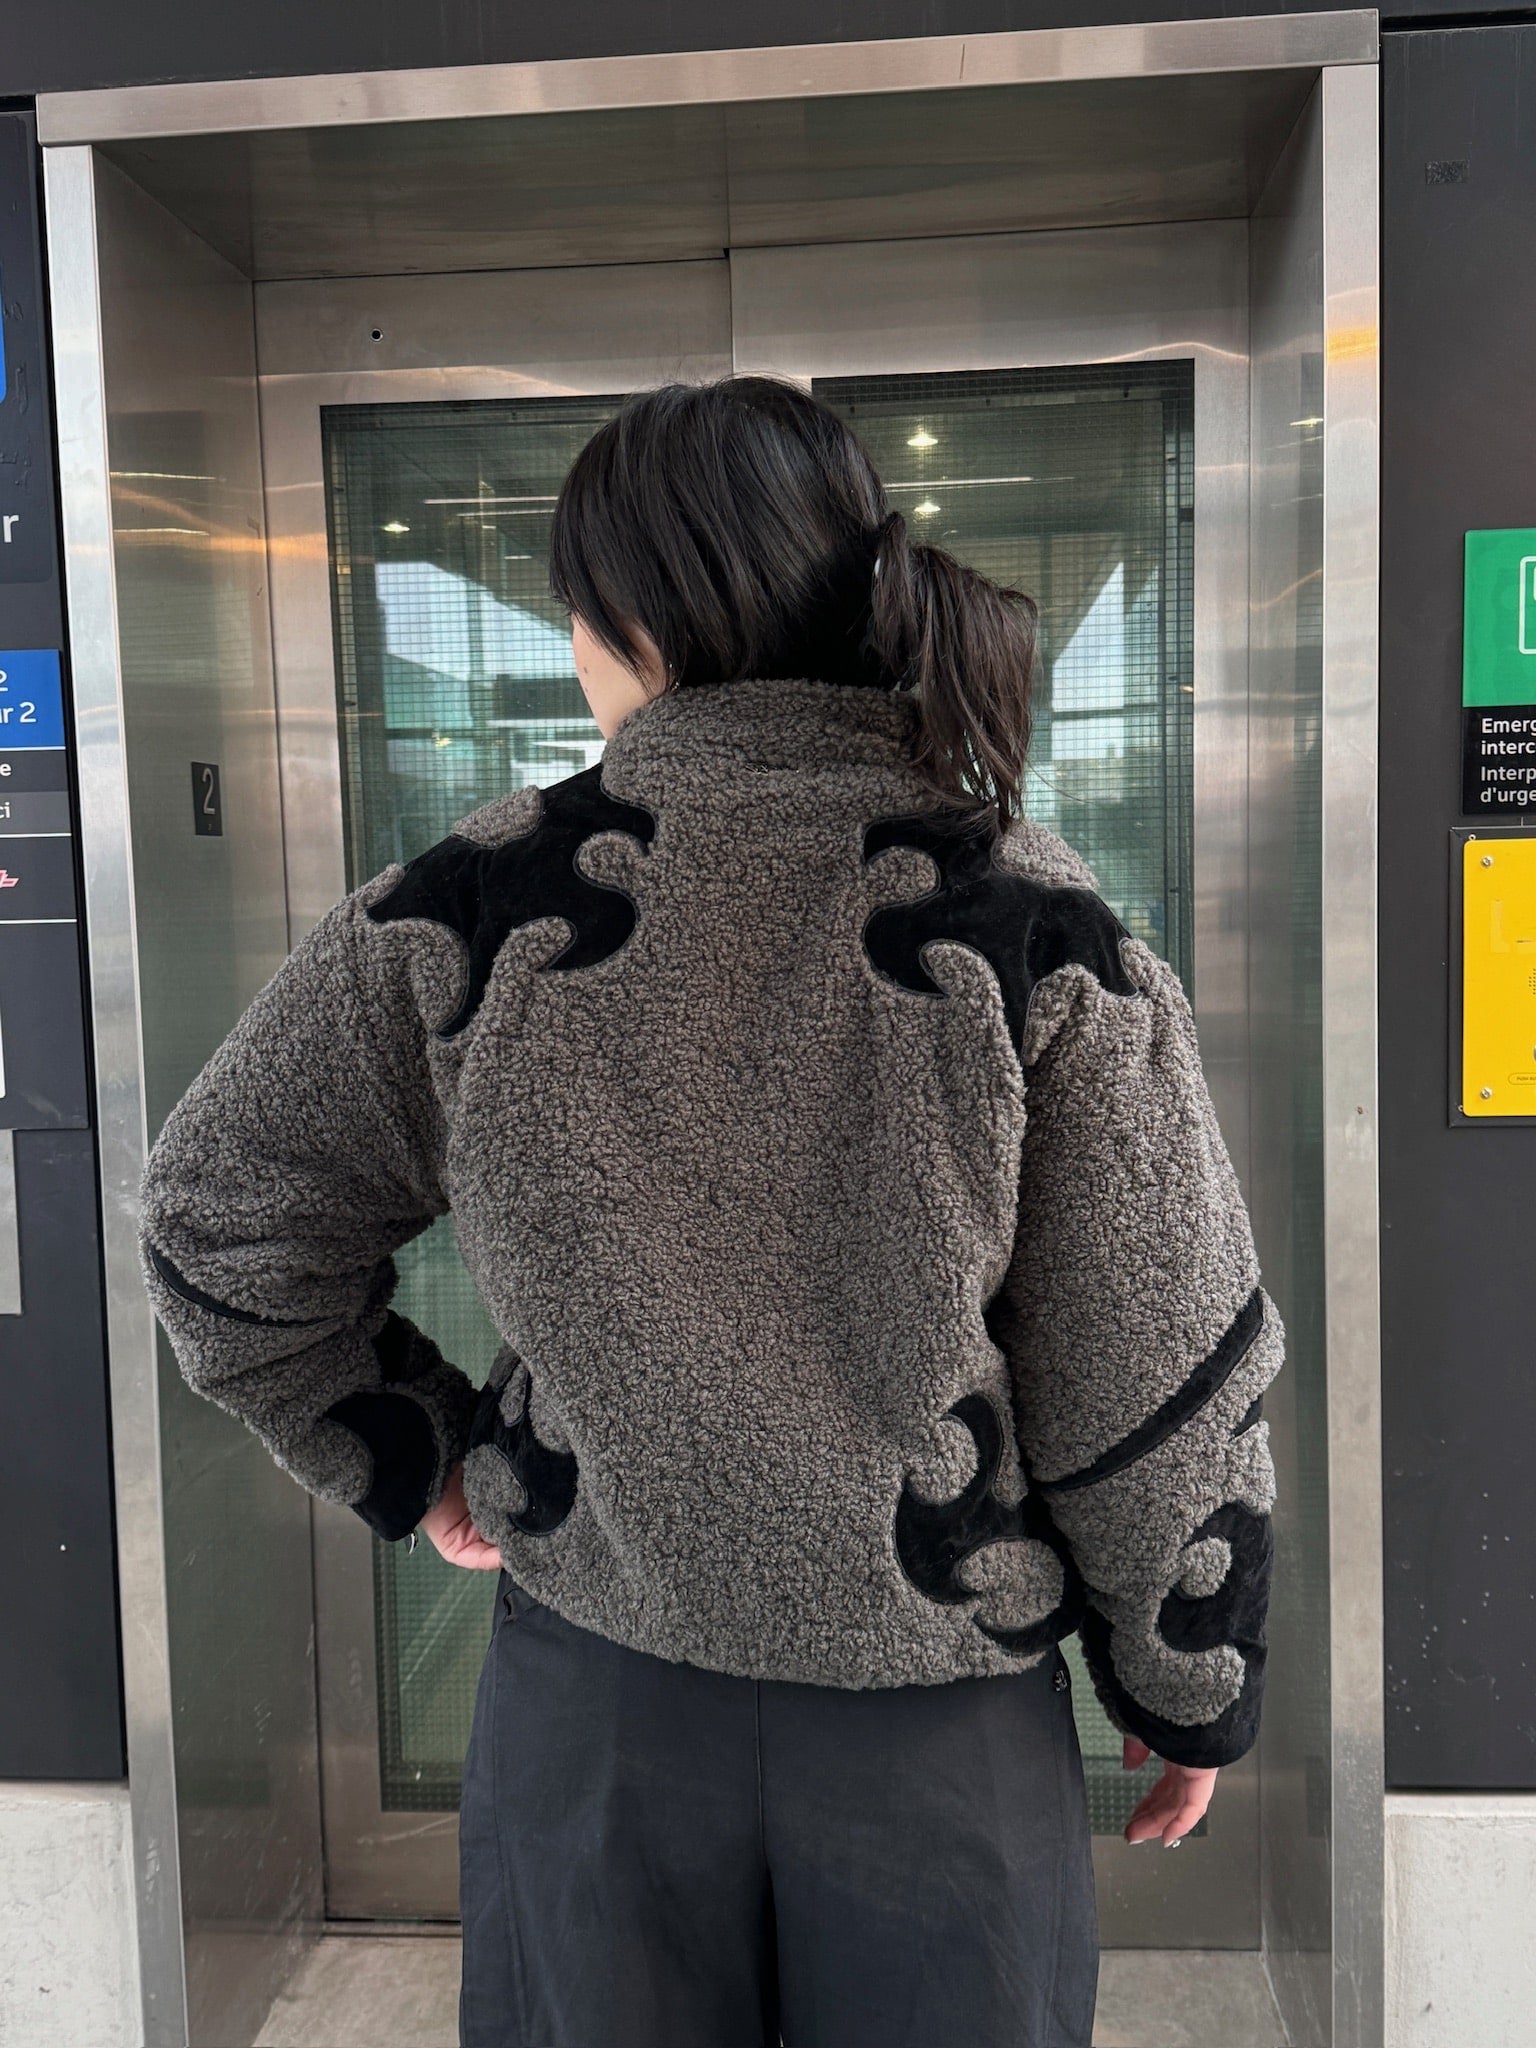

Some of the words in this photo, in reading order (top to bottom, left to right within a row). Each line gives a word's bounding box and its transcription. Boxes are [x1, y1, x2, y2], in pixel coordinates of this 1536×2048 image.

[20, 701, 36, 723] 2
[1481, 740, 1536, 755] interc
[1481, 766, 1536, 784] Interp
[202, 768, 215, 814] 2
[1480, 787, 1536, 806] d'urge
